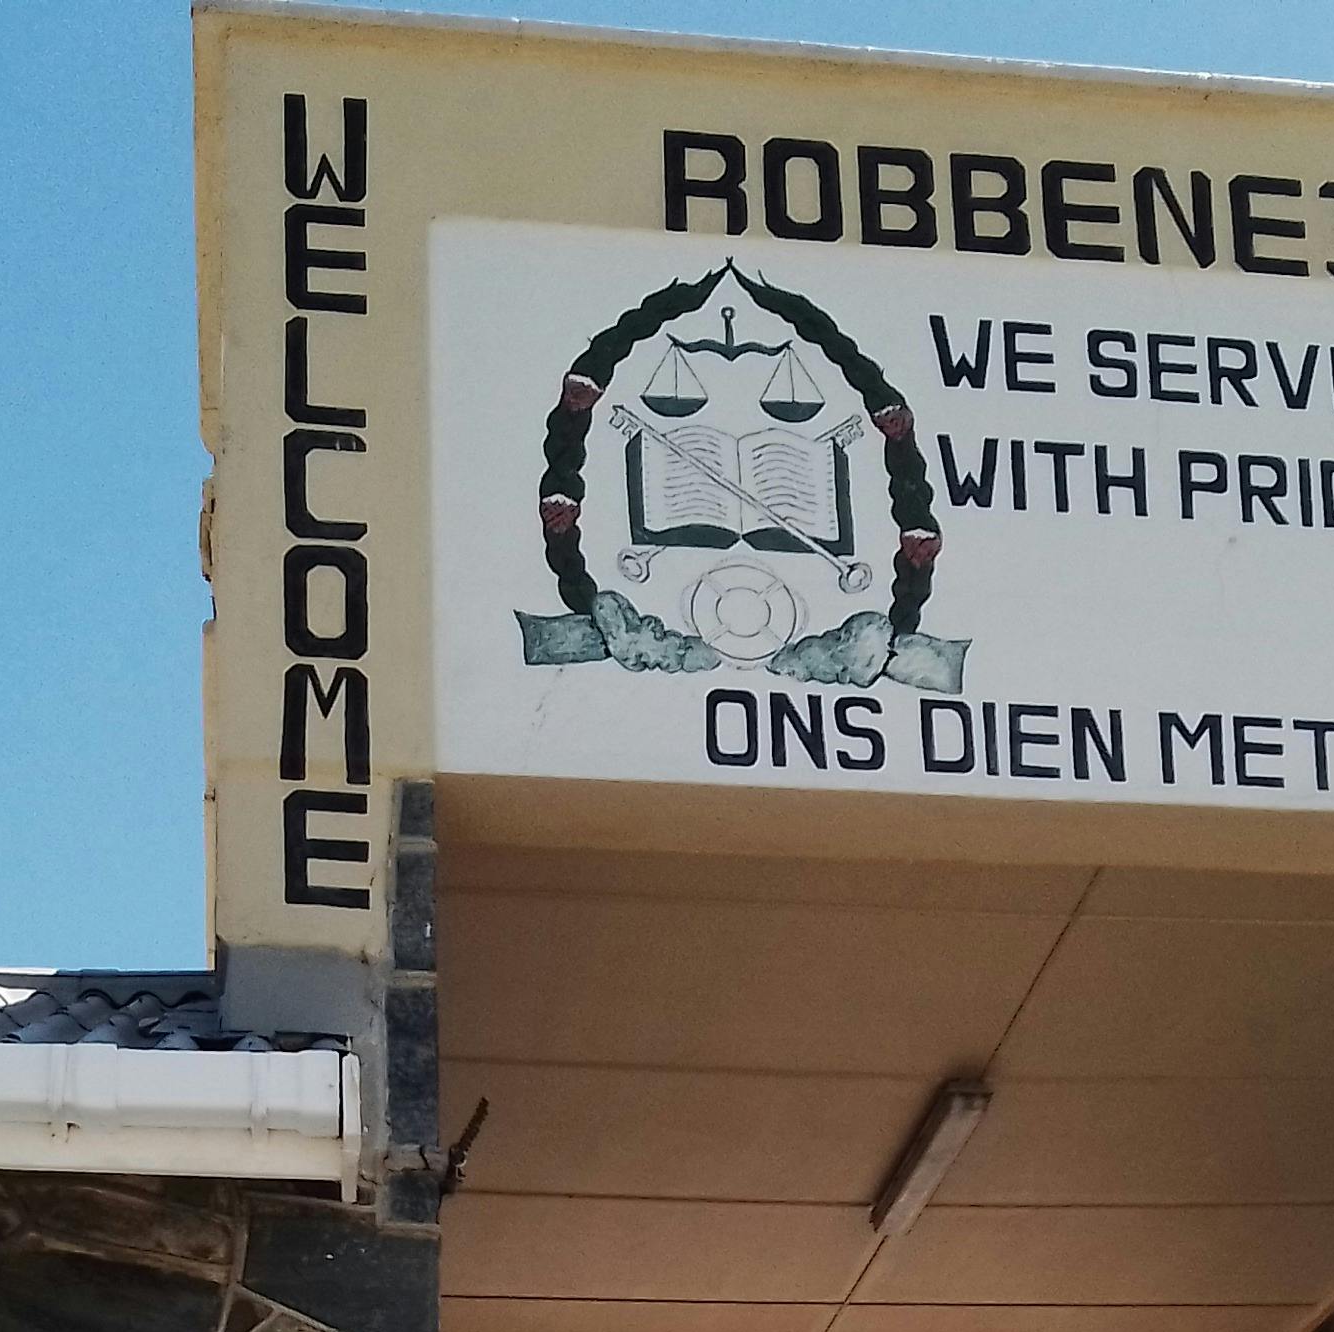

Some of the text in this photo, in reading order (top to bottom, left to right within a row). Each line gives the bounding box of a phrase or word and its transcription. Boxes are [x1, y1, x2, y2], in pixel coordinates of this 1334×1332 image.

[930, 315, 1056, 393] WE
[280, 93, 371, 909] WELCOME
[937, 434, 1149, 516] WITH
[707, 689, 885, 772] ONS
[920, 699, 1126, 782] DIEN
